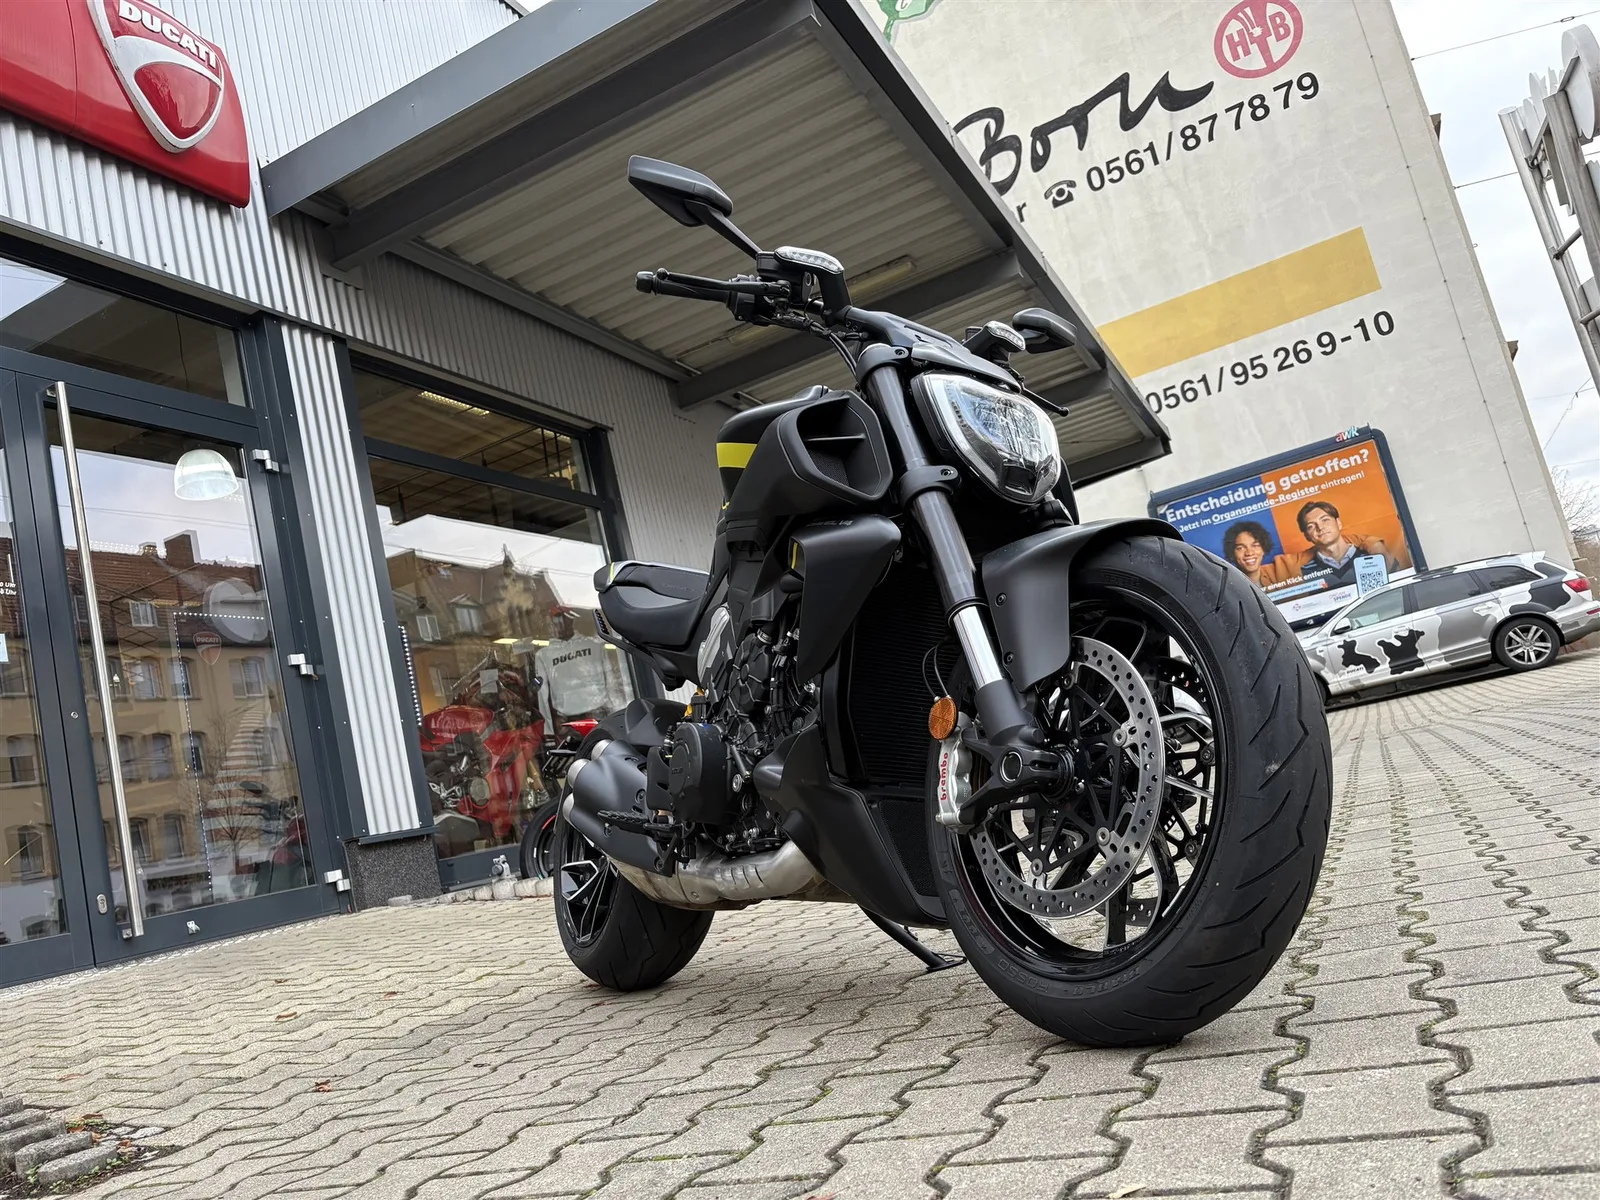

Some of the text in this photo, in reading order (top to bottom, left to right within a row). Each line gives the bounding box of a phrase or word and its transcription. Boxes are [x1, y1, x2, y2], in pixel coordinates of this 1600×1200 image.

[119, 1, 218, 69] DUCATI
[1335, 426, 1360, 442] awk
[1165, 448, 1369, 523] Entscheidung getroffen?
[1179, 470, 1365, 533] Jetzt im Organspende-Register eintragen!
[1268, 582, 1287, 591] einen
[1286, 576, 1303, 586] Klick
[1303, 567, 1334, 582] entfernt:
[552, 647, 592, 667] DUCATI
[940, 752, 949, 801] brembo
[998, 959, 1050, 994] ROSSO
